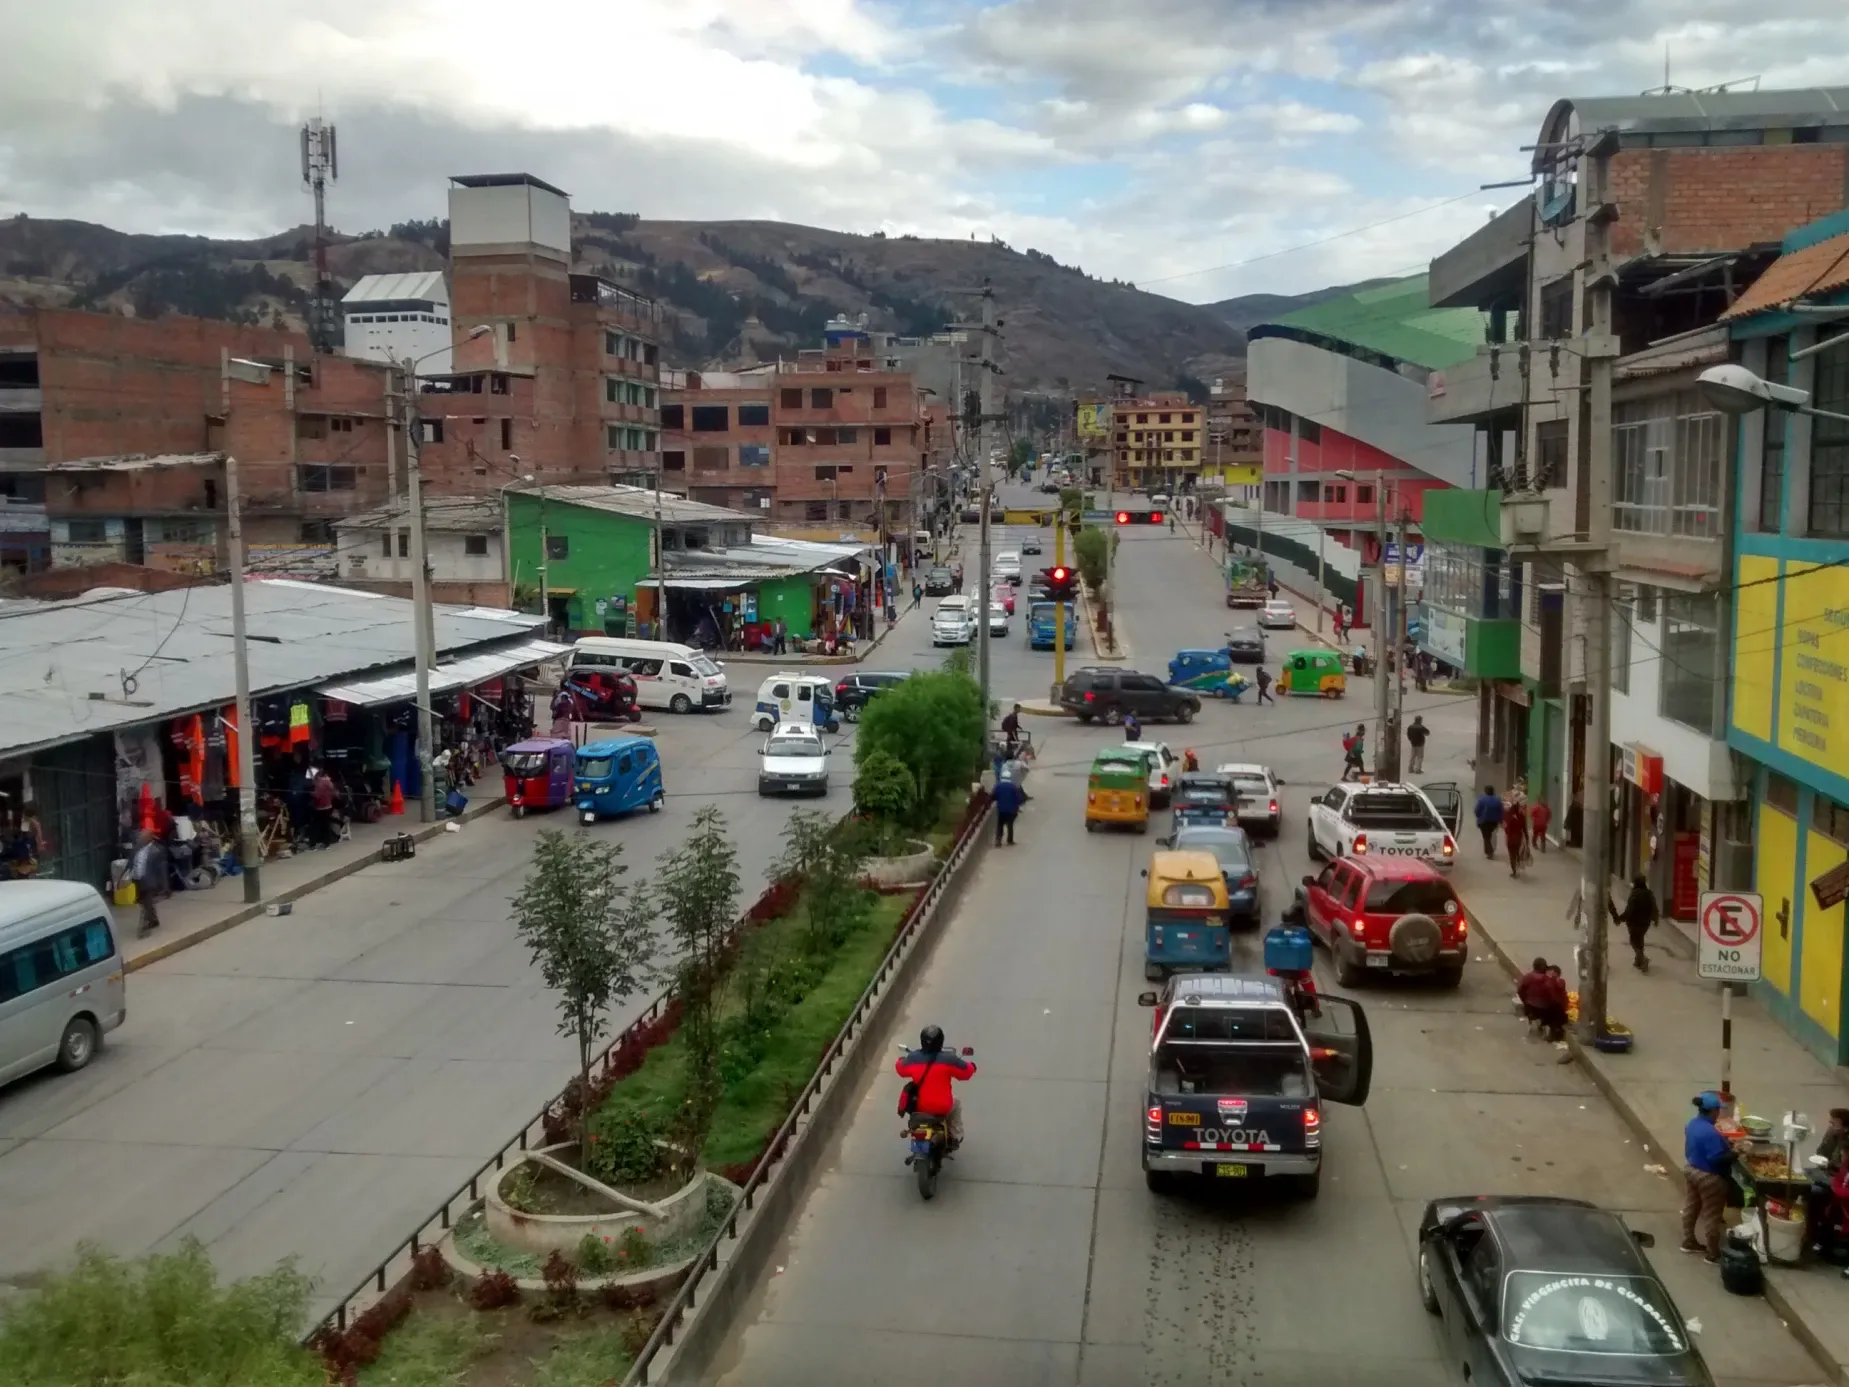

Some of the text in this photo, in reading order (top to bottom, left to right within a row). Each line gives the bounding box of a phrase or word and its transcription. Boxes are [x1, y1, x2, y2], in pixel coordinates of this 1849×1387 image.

[1379, 846, 1430, 857] TOYOTA
[1718, 950, 1741, 962] NO
[1702, 964, 1756, 976] ESTACIONAR
[1193, 1128, 1271, 1144] TOYOTA
[1521, 1277, 1590, 1311] VIRGENCITA
[1594, 1278, 1614, 1291] DE
